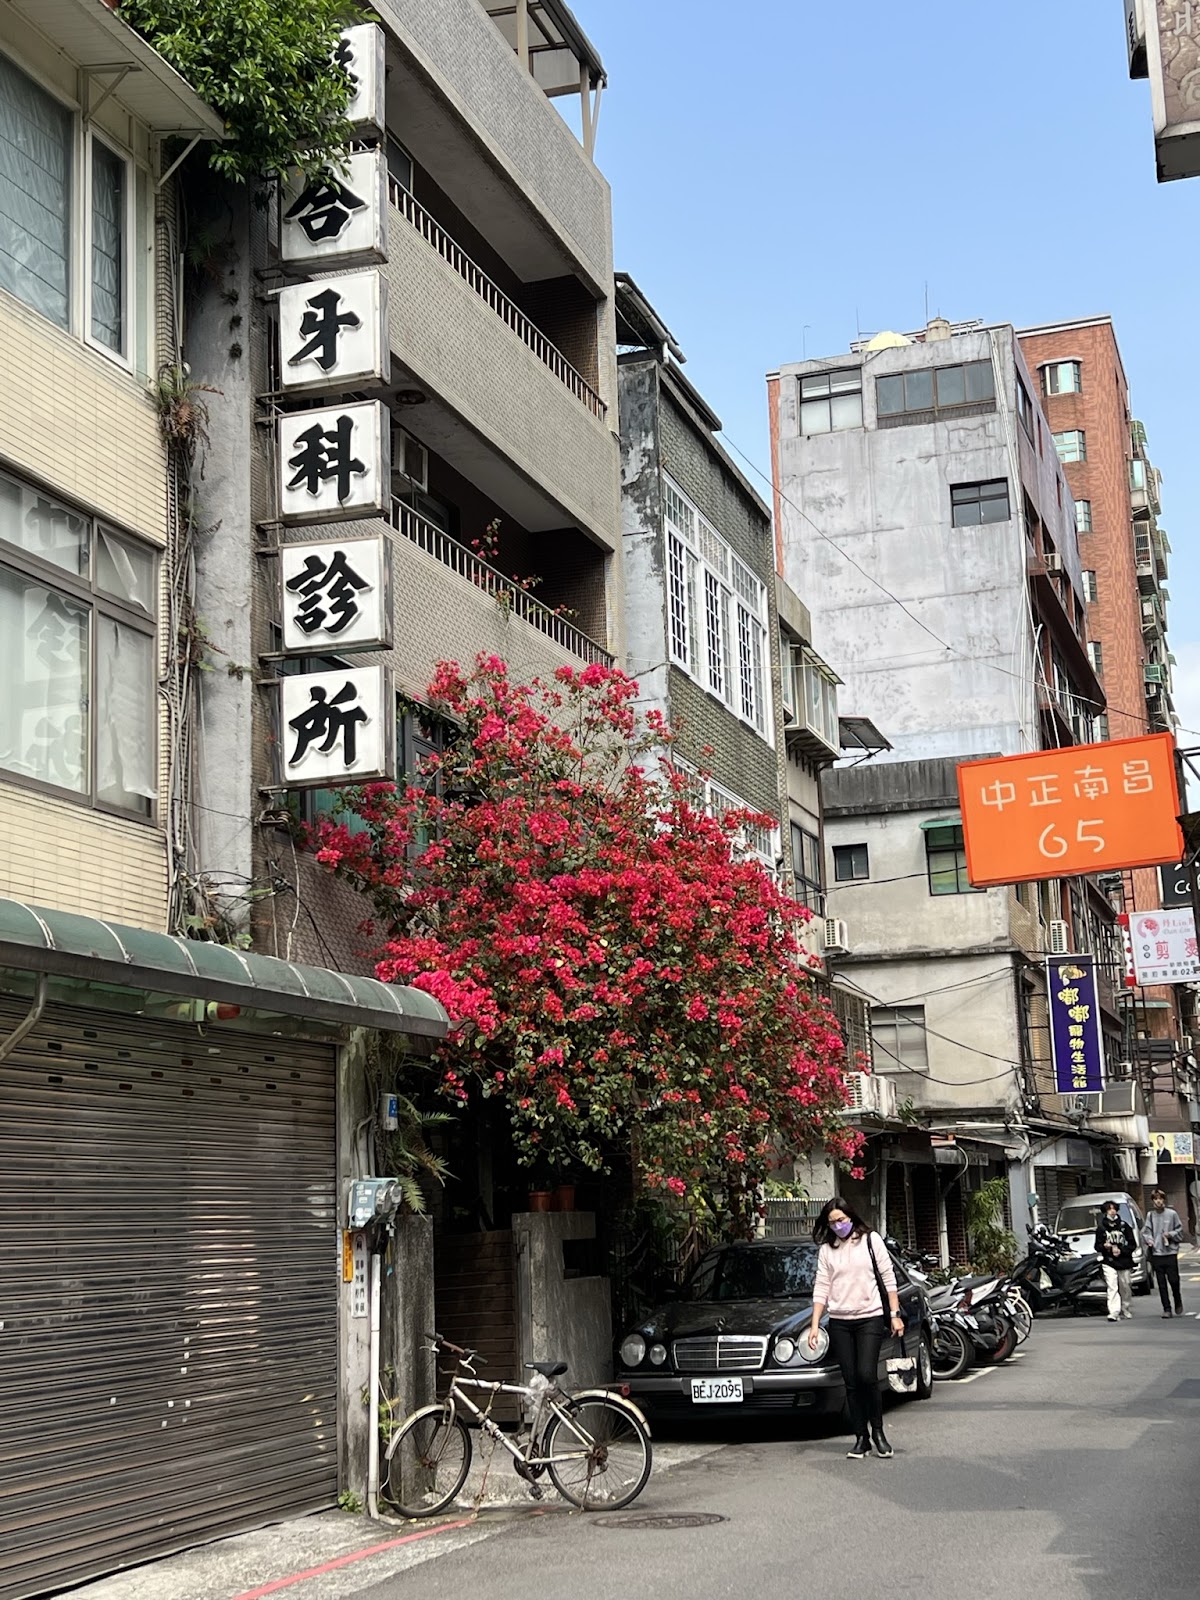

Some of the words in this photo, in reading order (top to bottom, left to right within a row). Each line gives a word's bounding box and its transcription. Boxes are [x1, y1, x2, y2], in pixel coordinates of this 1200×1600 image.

[285, 38, 369, 767] 合牙科診所
[980, 758, 1154, 813] 中正南昌
[1038, 819, 1106, 859] 65
